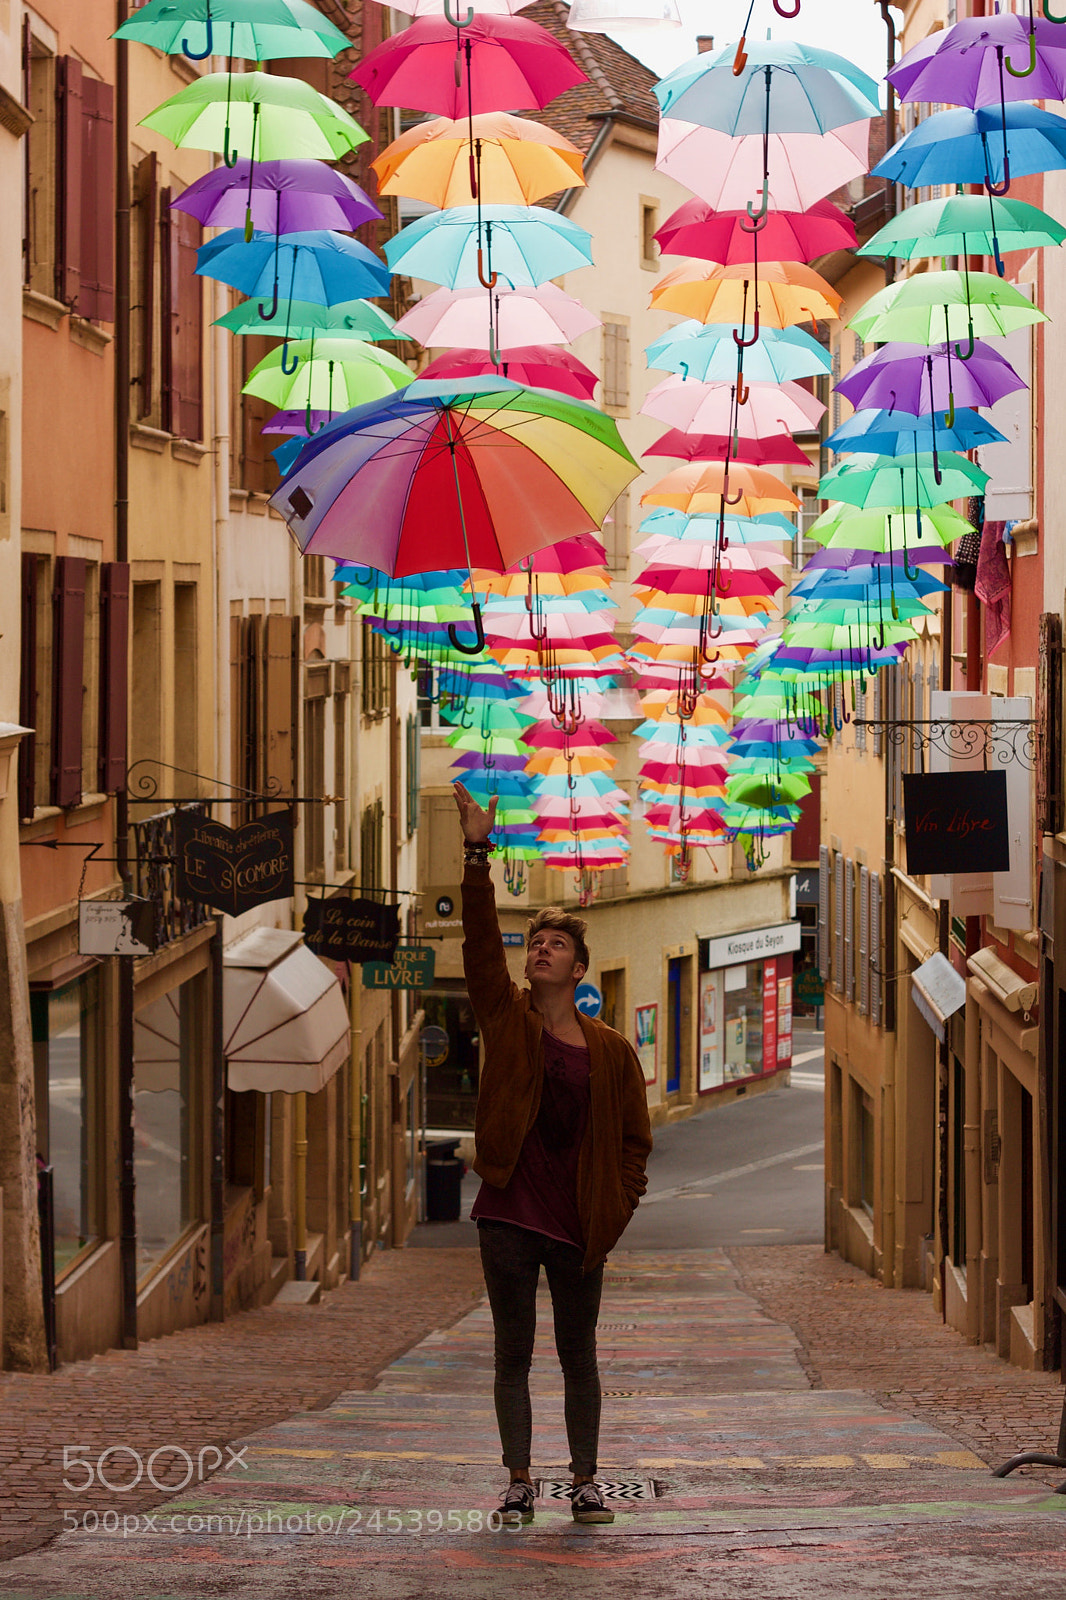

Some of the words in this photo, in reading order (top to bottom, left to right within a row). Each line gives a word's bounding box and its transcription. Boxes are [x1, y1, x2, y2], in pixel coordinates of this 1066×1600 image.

[915, 808, 938, 834] Vin
[947, 807, 995, 839] Libre
[193, 828, 234, 854] Librairie
[184, 855, 207, 879] LE
[326, 908, 344, 925] Le
[346, 915, 376, 929] coin
[308, 929, 324, 943] de
[328, 930, 343, 945] la
[345, 930, 393, 950] Danse
[727, 940, 754, 956] Kiosque
[755, 937, 764, 950] du
[765, 934, 784, 949] Seyon
[374, 970, 425, 986] LIVRE
